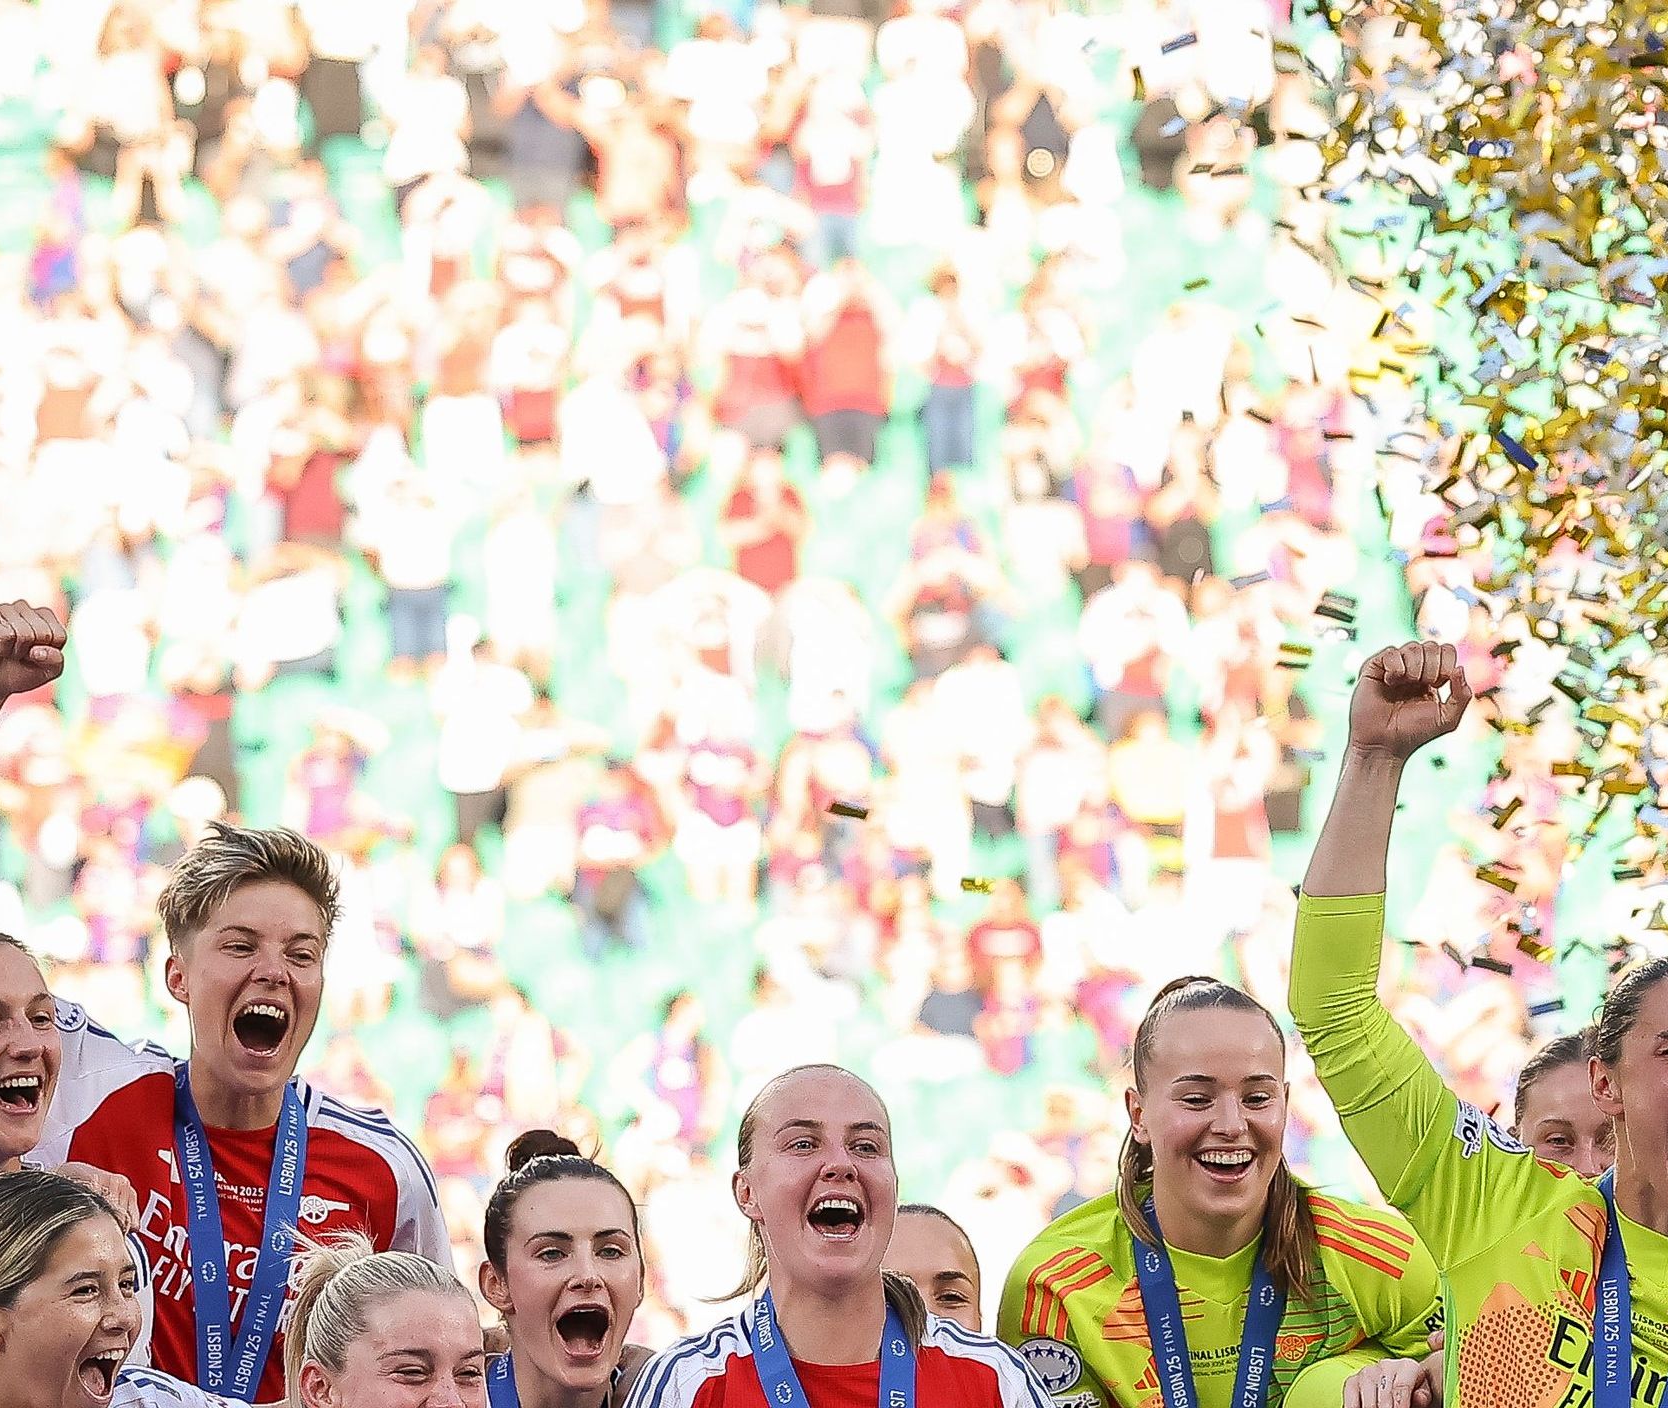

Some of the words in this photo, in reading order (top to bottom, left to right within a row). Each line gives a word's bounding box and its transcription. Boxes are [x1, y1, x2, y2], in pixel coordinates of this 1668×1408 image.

[287, 1103, 298, 1135] FINAL
[184, 1124, 201, 1163] LISBON
[193, 1182, 207, 1220] FINAL
[279, 1154, 296, 1196] LISBON
[151, 1255, 192, 1300] FLY
[1602, 1279, 1619, 1325] LISBON
[205, 1323, 221, 1367] LISBON
[232, 1352, 254, 1396] LISBON
[254, 1294, 272, 1331] FINAL
[1161, 1313, 1176, 1353] FINAL
[1244, 1346, 1266, 1395] LISBON
[1606, 1346, 1618, 1387] FINAL
